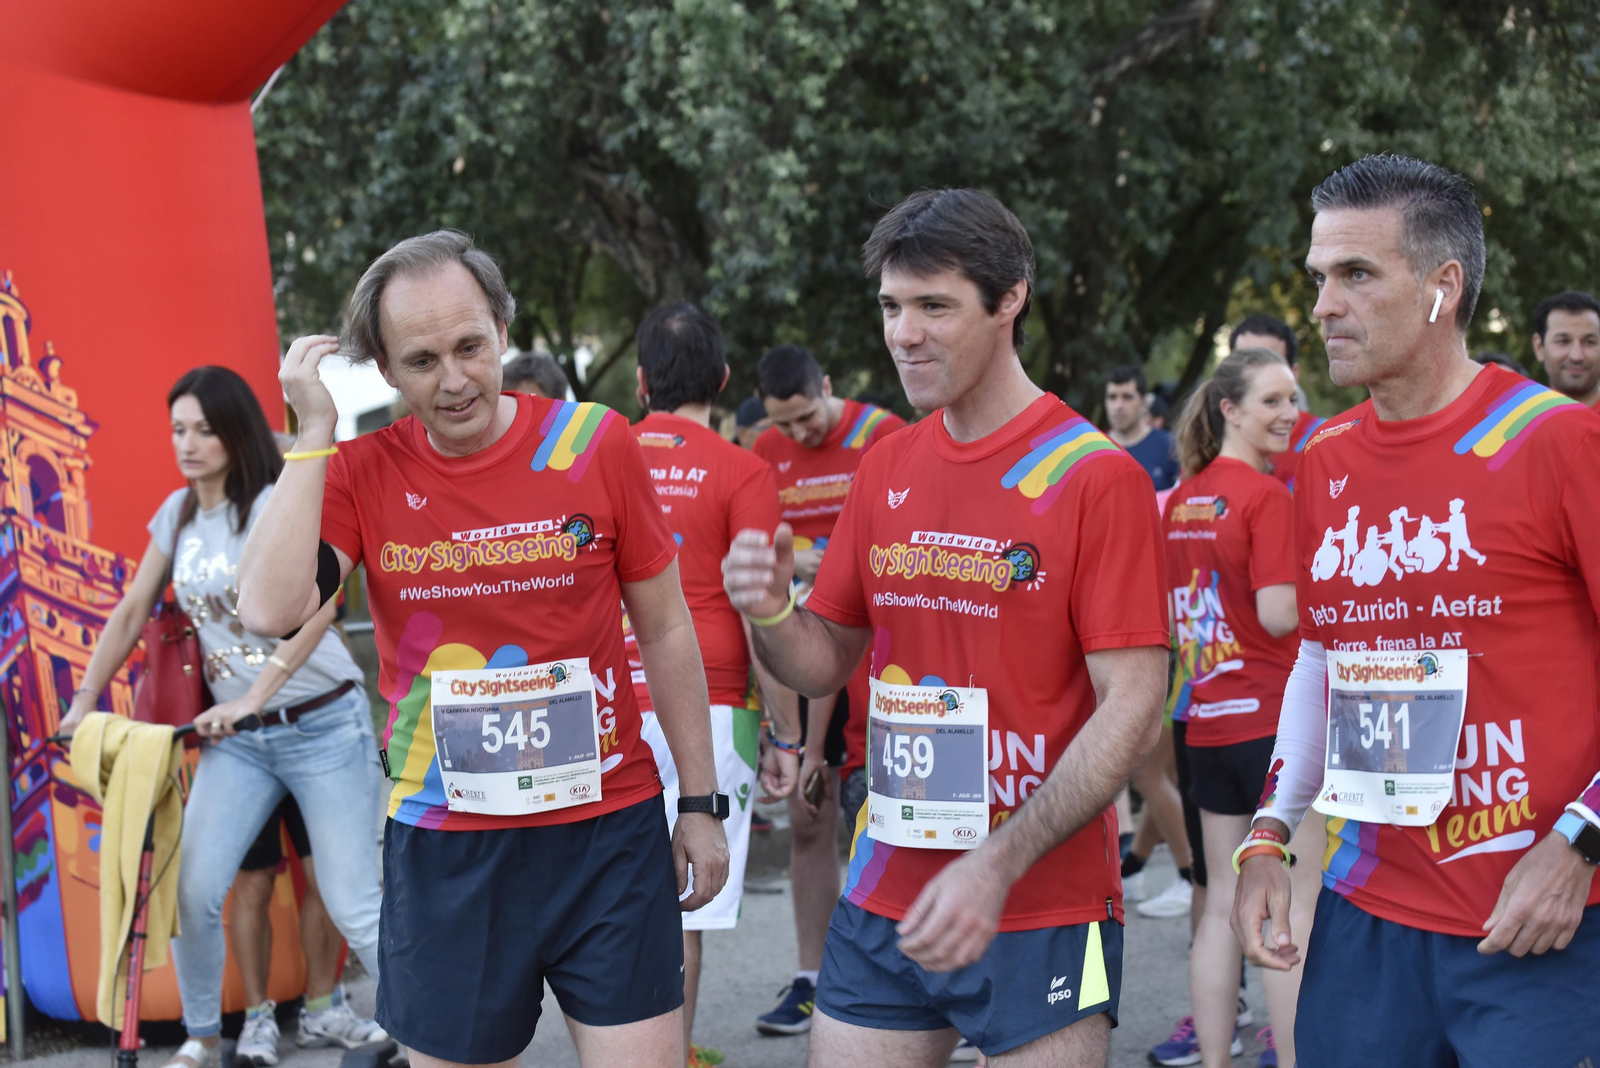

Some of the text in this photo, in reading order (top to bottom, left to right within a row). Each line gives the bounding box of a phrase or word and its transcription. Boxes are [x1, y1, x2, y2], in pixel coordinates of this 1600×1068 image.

[686, 467, 708, 483] AT
[460, 521, 551, 541] Worldwide
[918, 532, 992, 551] Worldwide
[399, 573, 575, 601] #WeShowYouTheWorld
[1173, 586, 1225, 620] RUN
[1342, 597, 1409, 623] Zurich
[1431, 595, 1503, 617] Aefat
[1375, 635, 1417, 651] frena
[1420, 633, 1436, 649] la
[1441, 632, 1462, 647] AT
[495, 668, 544, 678] Worldwide
[559, 695, 582, 704] ALAMILLO
[482, 708, 551, 754] 545
[1359, 703, 1410, 749] 541
[883, 733, 934, 779] 459
[1455, 719, 1525, 769] UN
